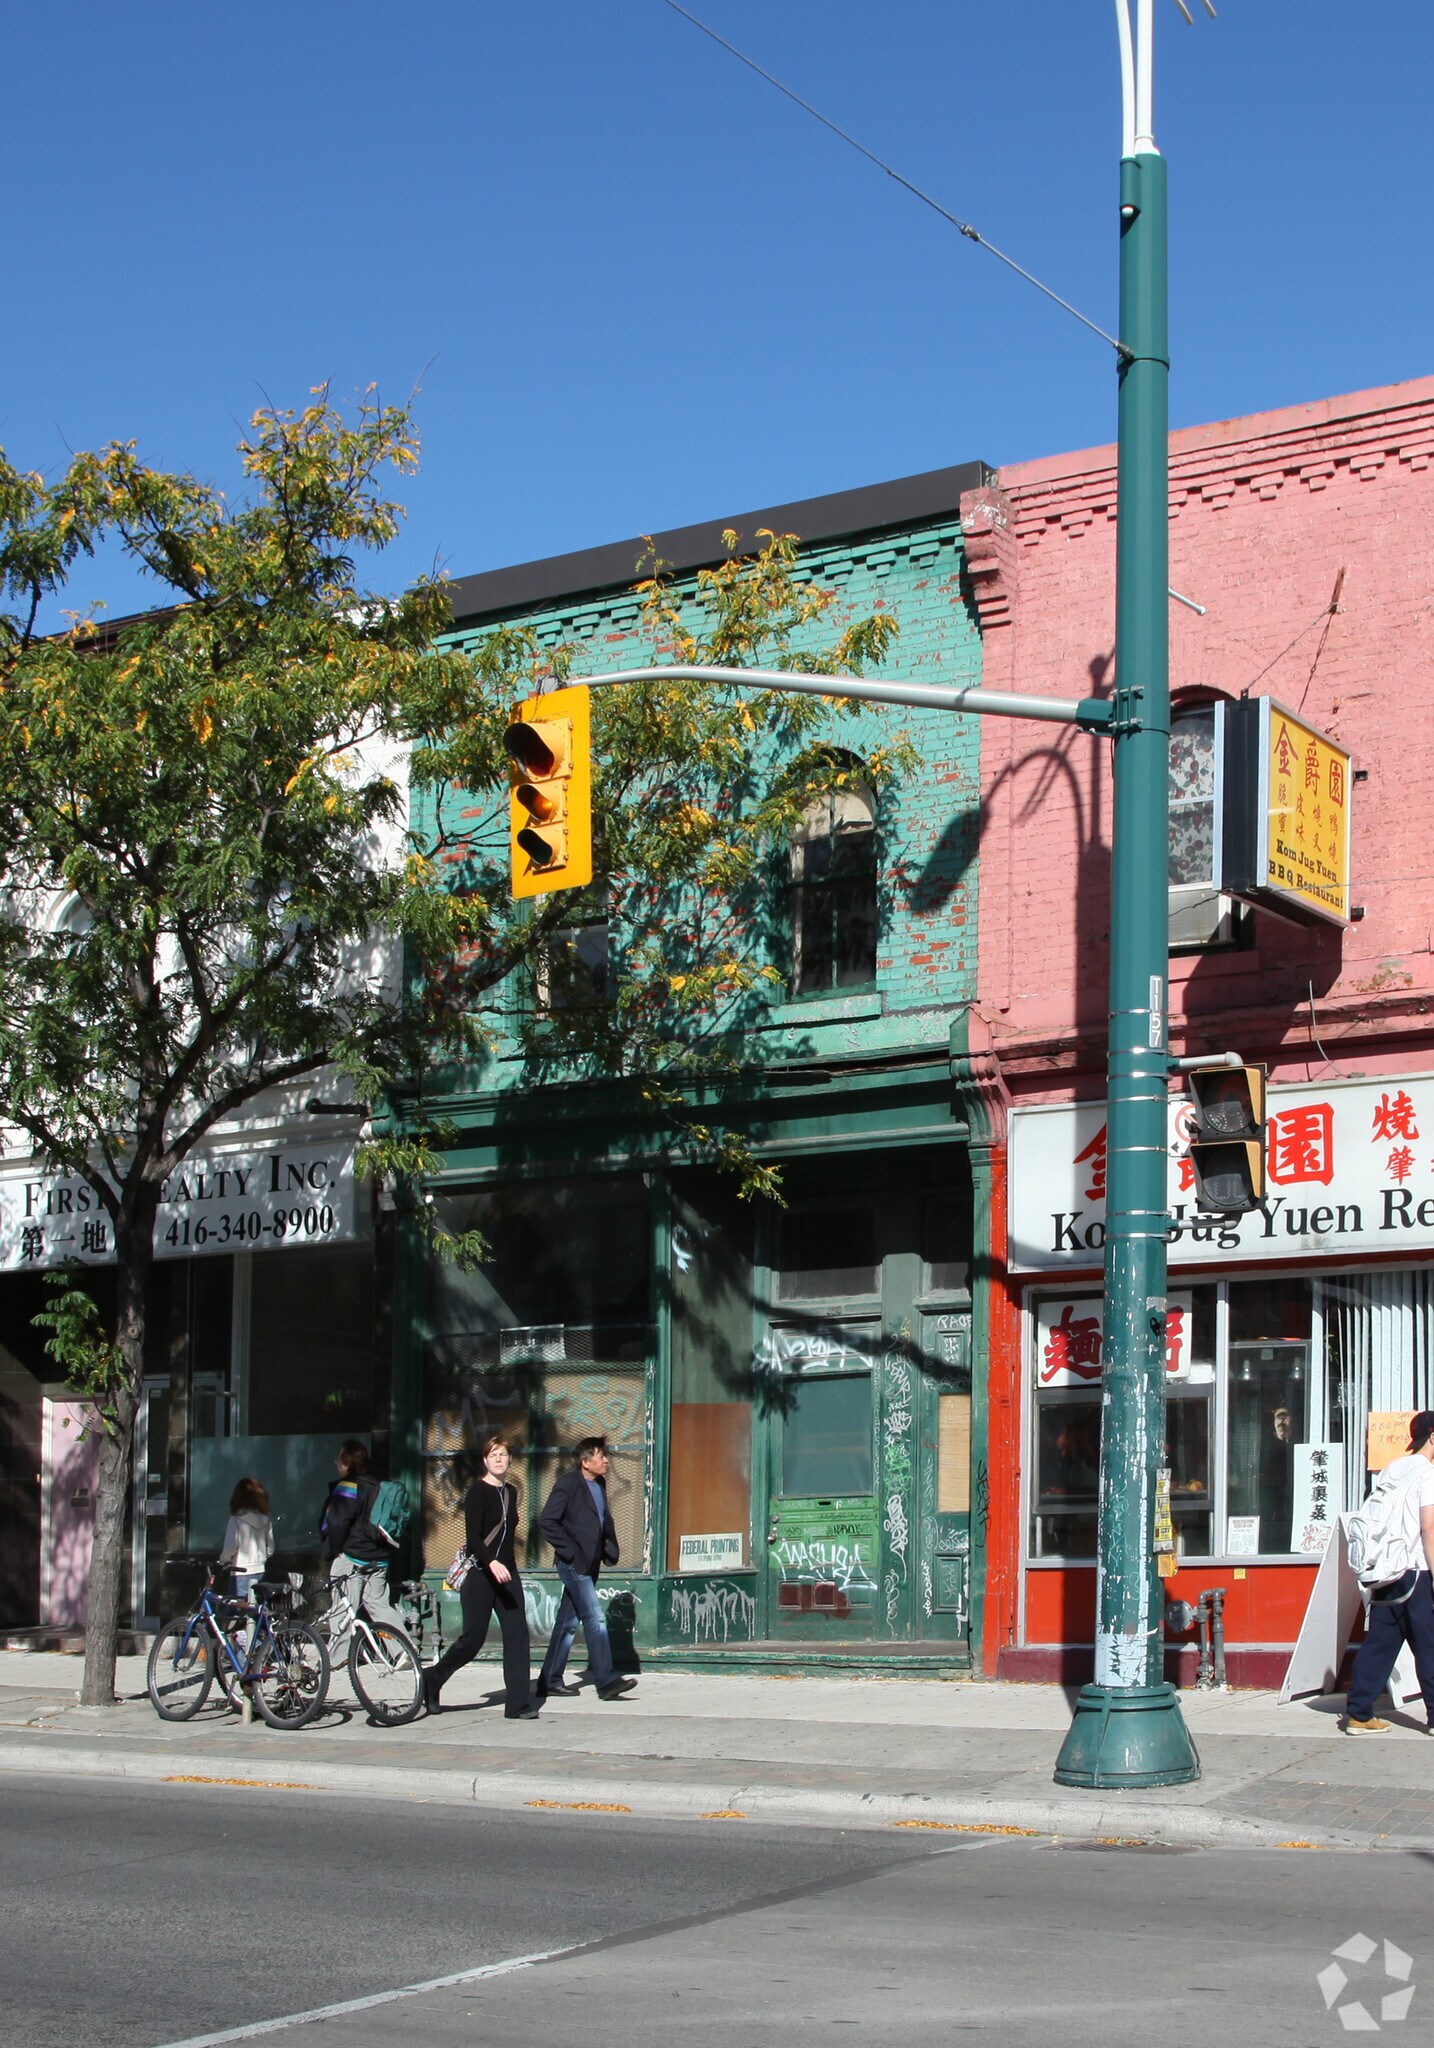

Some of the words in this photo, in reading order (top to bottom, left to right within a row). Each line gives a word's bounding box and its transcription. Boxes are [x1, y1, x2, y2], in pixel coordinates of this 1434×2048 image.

[1276, 839, 1297, 862] Kom
[1298, 851, 1315, 874] Jug
[1316, 860, 1338, 883] Yuen
[1296, 873, 1344, 909] Restaurant
[152, 1168, 253, 1204] EALTY
[1384, 1145, 1434, 1187] 肇
[19, 1219, 118, 1262] 第一地
[165, 1204, 334, 1247] 416-340-8900
[1051, 1211, 1107, 1252] Ko
[1259, 1197, 1364, 1238] Yuen
[682, 1539, 708, 1555] FEDERAL
[710, 1537, 740, 1554] PRINTING
